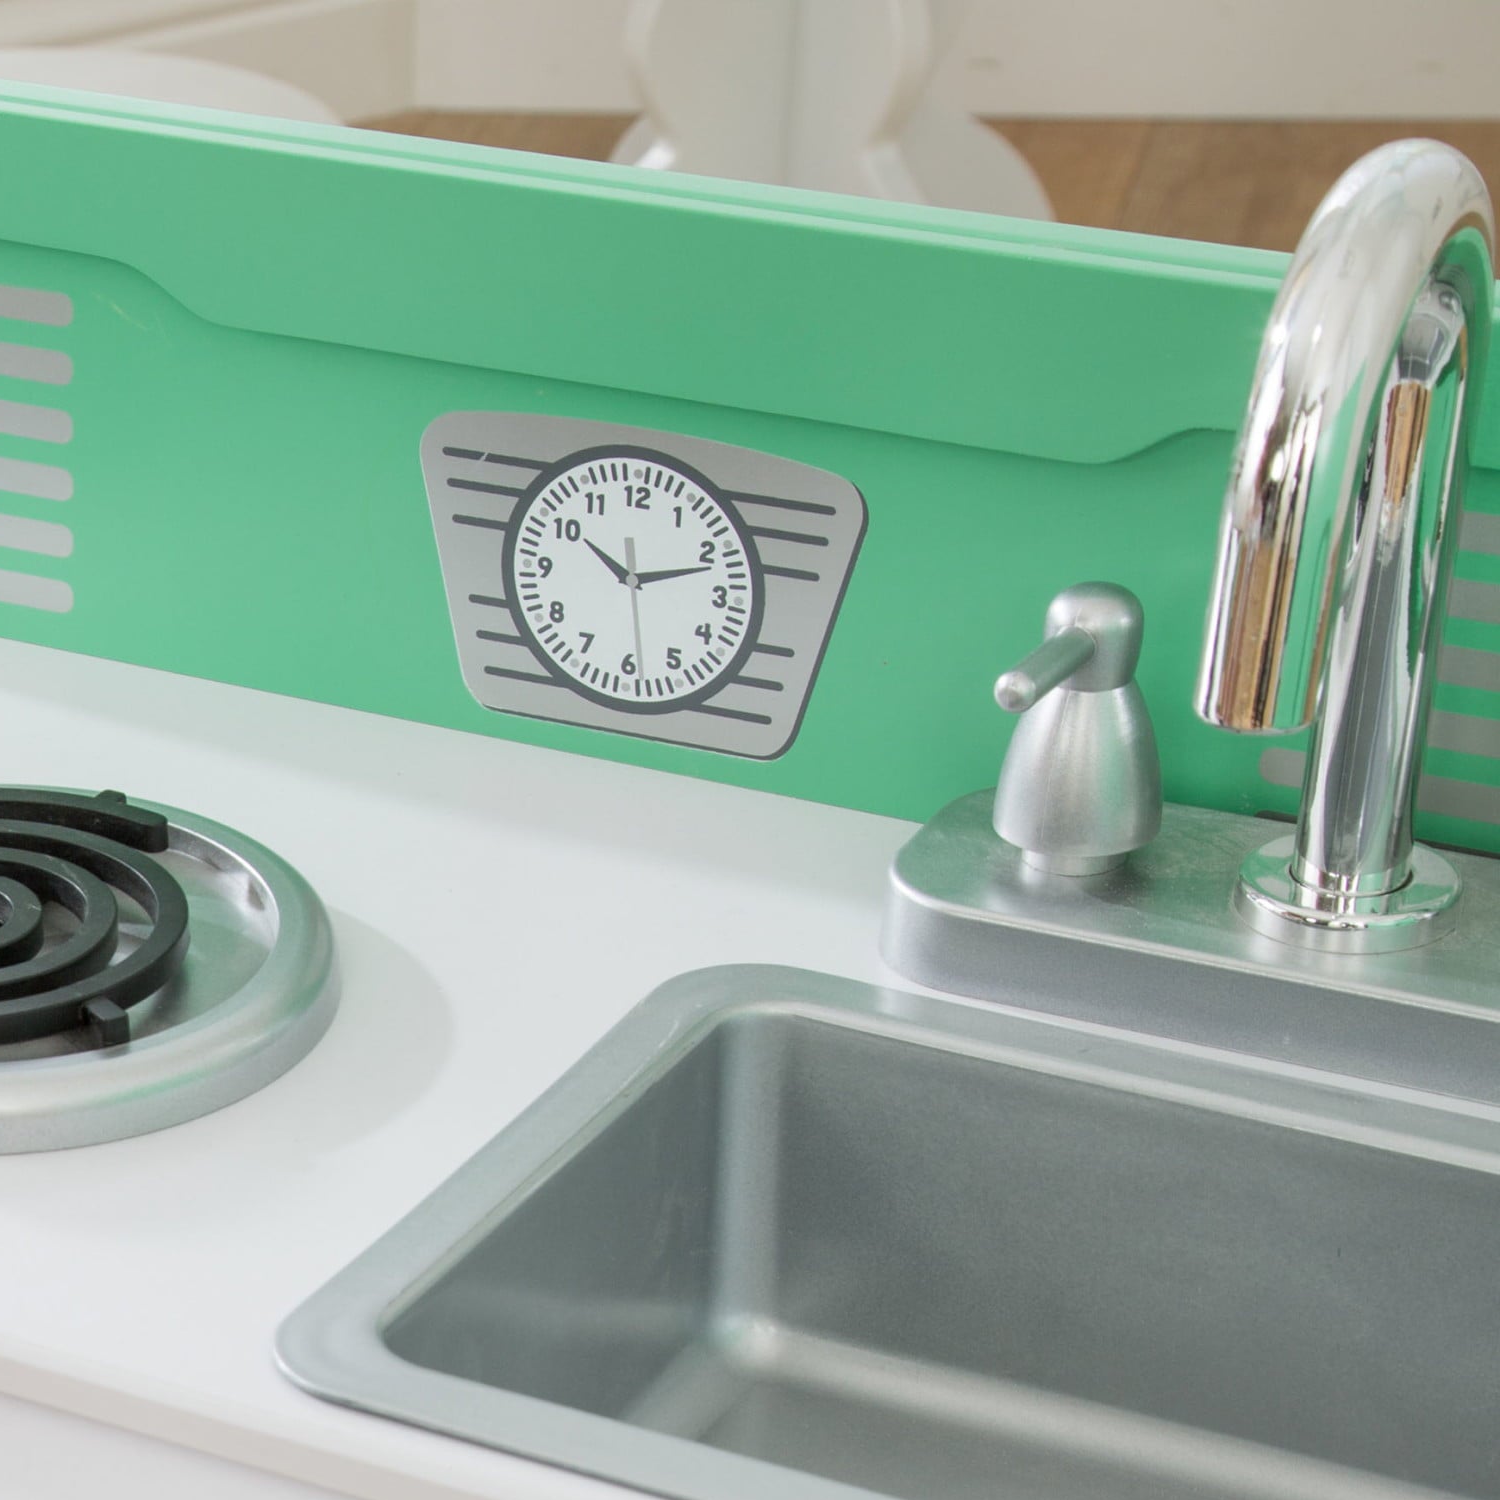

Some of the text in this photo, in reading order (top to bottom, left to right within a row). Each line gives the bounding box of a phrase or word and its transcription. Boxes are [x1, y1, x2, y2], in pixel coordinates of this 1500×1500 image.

[585, 492, 604, 515] 11
[624, 485, 651, 510] 12
[673, 506, 682, 528] 1
[554, 518, 580, 542] 10
[699, 541, 715, 564] 2
[537, 556, 553, 578] 9
[712, 586, 727, 608] 3
[550, 601, 564, 623] 8
[579, 632, 595, 653] 7
[695, 623, 712, 645] 4
[621, 654, 636, 675] 6
[666, 648, 681, 669] 5
